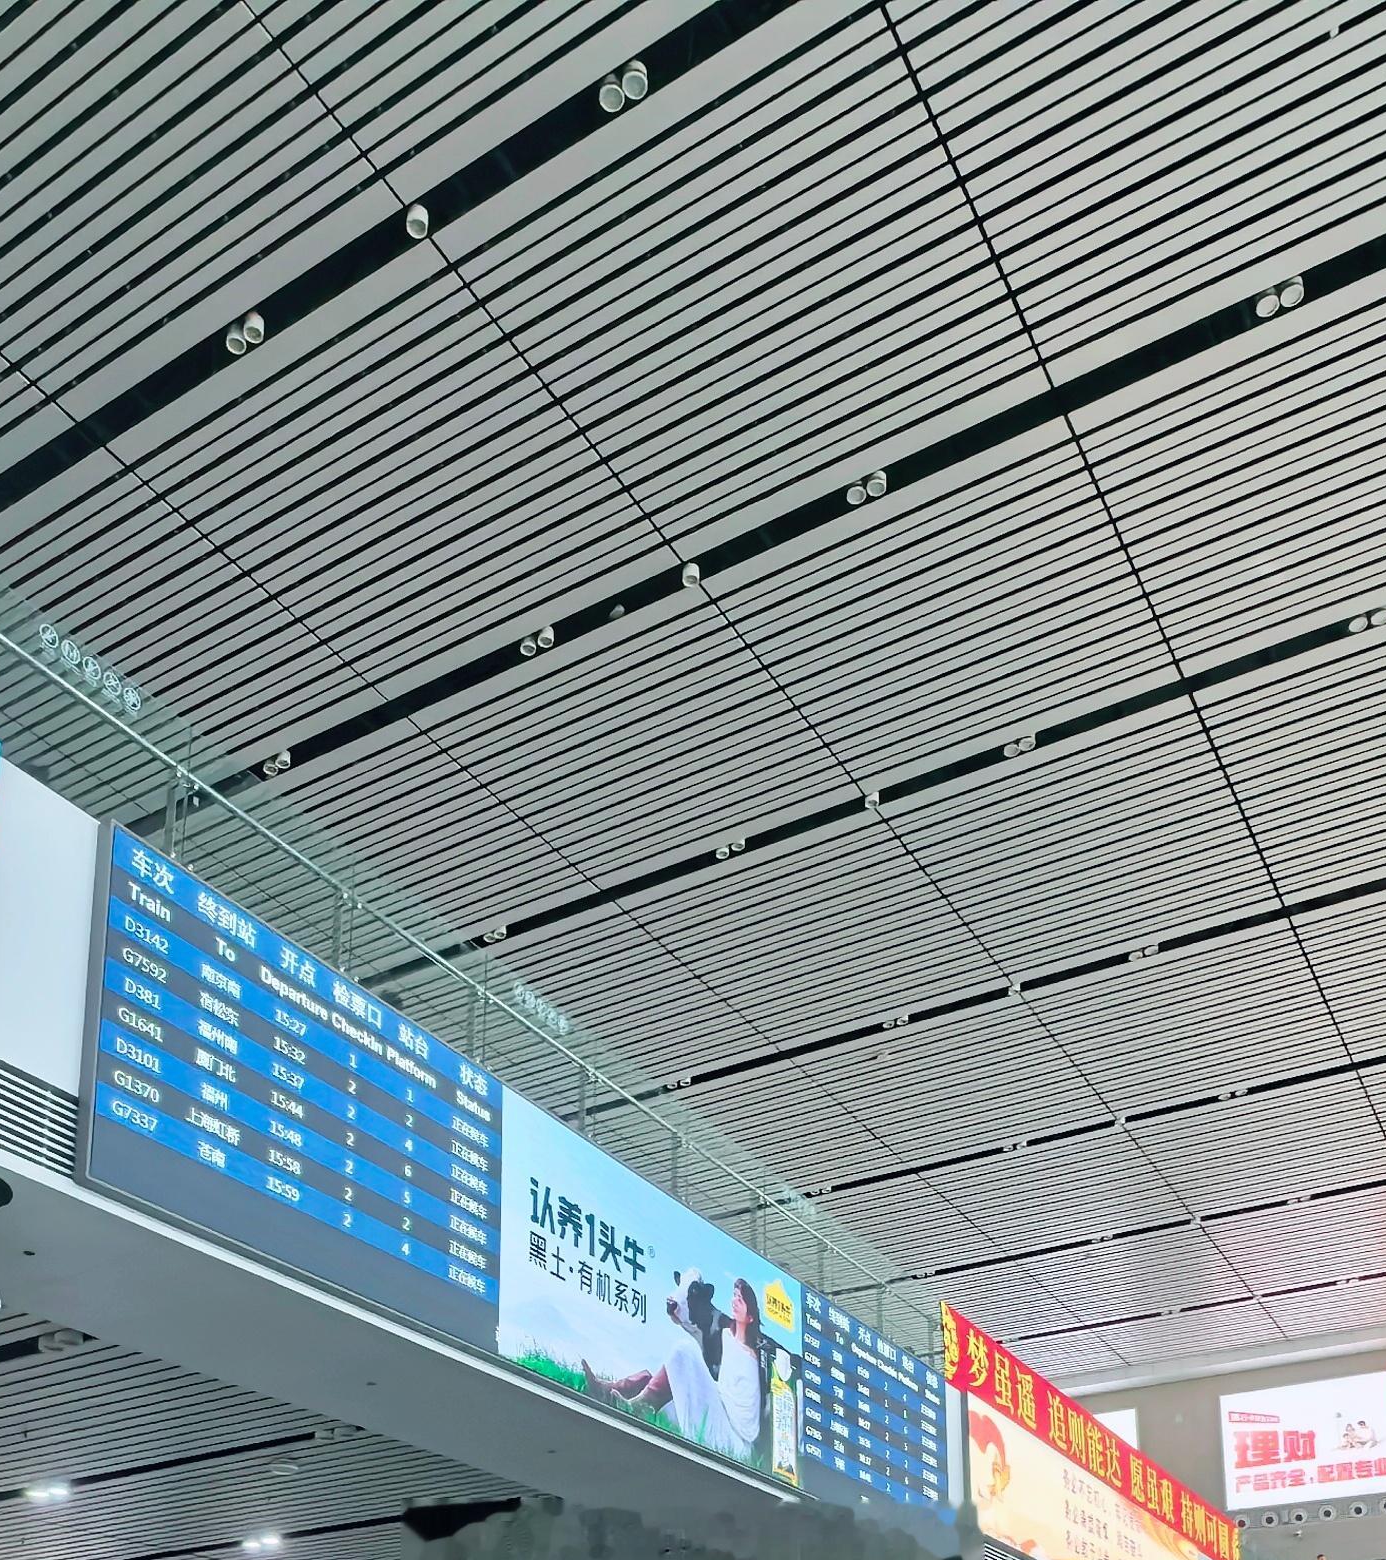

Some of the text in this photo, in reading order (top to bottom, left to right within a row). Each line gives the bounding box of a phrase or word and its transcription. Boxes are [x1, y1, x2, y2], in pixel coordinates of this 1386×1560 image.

[122, 947, 168, 984] G7592
[273, 1036, 306, 1065] 15:32
[348, 1080, 357, 1095] 2
[405, 1115, 413, 1128] 2
[124, 915, 170, 955] D3142
[275, 1008, 307, 1036] 15:27
[349, 1054, 357, 1068] 1
[406, 1090, 413, 1102] 1
[128, 881, 171, 921] Train
[215, 936, 236, 962] To
[259, 965, 328, 1020] Departure
[387, 1047, 437, 1090] Platform
[456, 1090, 491, 1122] Status
[131, 849, 489, 1097] 车次 终到站 开点 检票口 站台 状态
[116, 1037, 161, 1074] D3101
[269, 1120, 302, 1148] 15:48
[345, 1160, 354, 1174] 2
[404, 1191, 411, 1203] 5
[118, 1006, 163, 1043] G1641
[271, 1090, 303, 1119] 15:44
[346, 1133, 355, 1146] 2
[404, 1165, 412, 1177] 6
[124, 977, 162, 1010] D381
[271, 1062, 305, 1090] 15:37
[347, 1106, 356, 1119] 2
[404, 1140, 413, 1151] 4
[112, 1100, 158, 1131] G7337
[266, 1176, 300, 1201] 15:59
[343, 1214, 352, 1227] 2
[402, 1243, 410, 1255] 4
[114, 1070, 160, 1103] G1370
[185, 1108, 241, 1146] 上海虹桥
[268, 1149, 301, 1175] 15:58
[344, 1188, 353, 1201] 2
[403, 1217, 410, 1231] 2
[530, 1177, 646, 1281] 认养1头牛
[966, 1328, 1037, 1430] 梦虽遥
[1047, 1390, 1122, 1488] 追则能达
